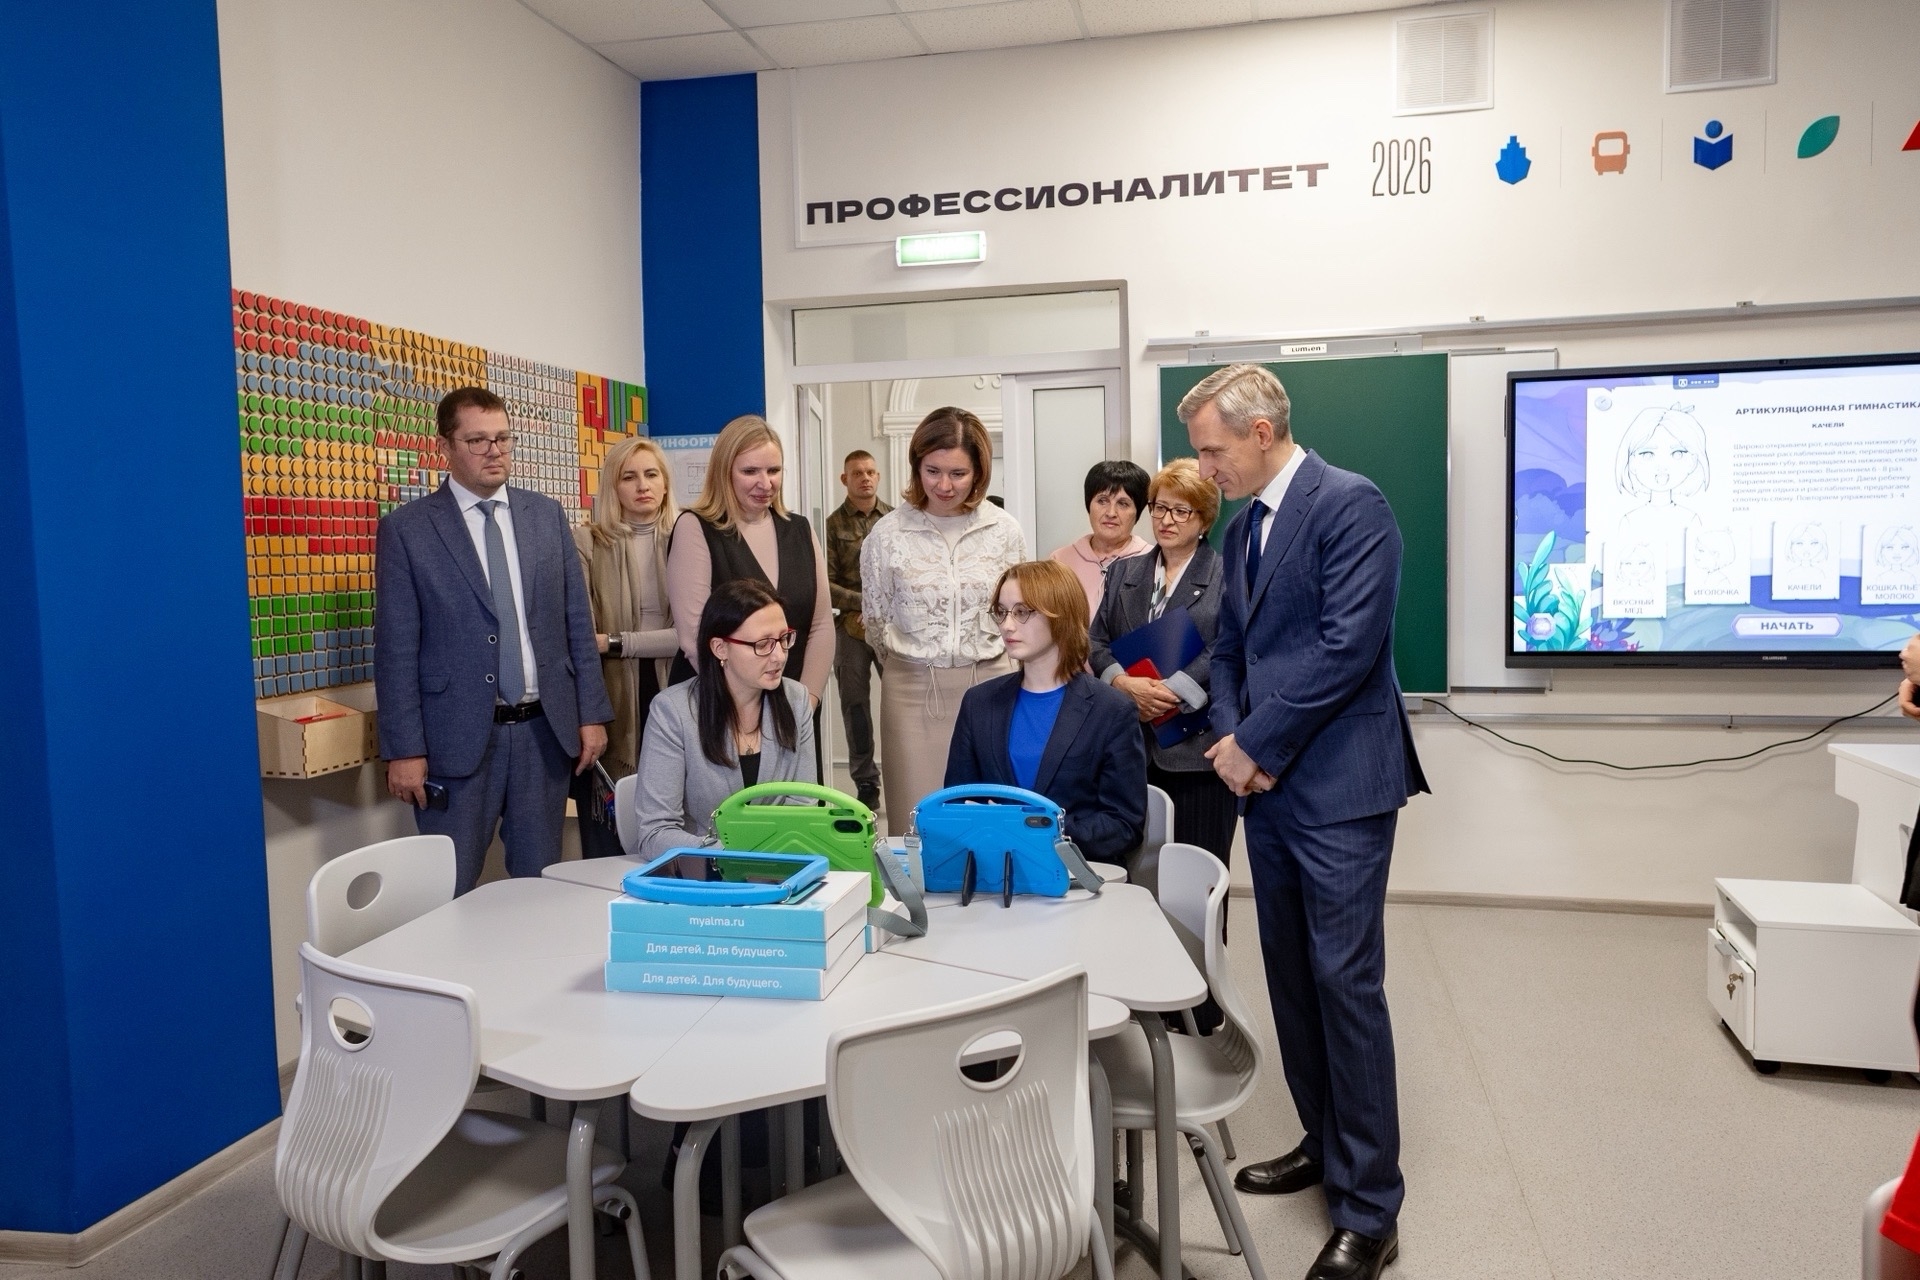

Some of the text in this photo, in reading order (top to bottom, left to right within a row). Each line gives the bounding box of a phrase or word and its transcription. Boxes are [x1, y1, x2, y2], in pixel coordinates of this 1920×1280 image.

[806, 136, 1433, 226] ПРОФЕССИОНАЛИТЕТ 2026
[1735, 404, 1845, 415] АРТИКУЛЯЦИОННАЯ
[1760, 622, 1814, 631] НАЧАТЬ
[689, 915, 745, 928] myalma.ru
[646, 942, 788, 959] Для детей. Для будущего.
[642, 972, 782, 990] Для детей. Для будущего.
